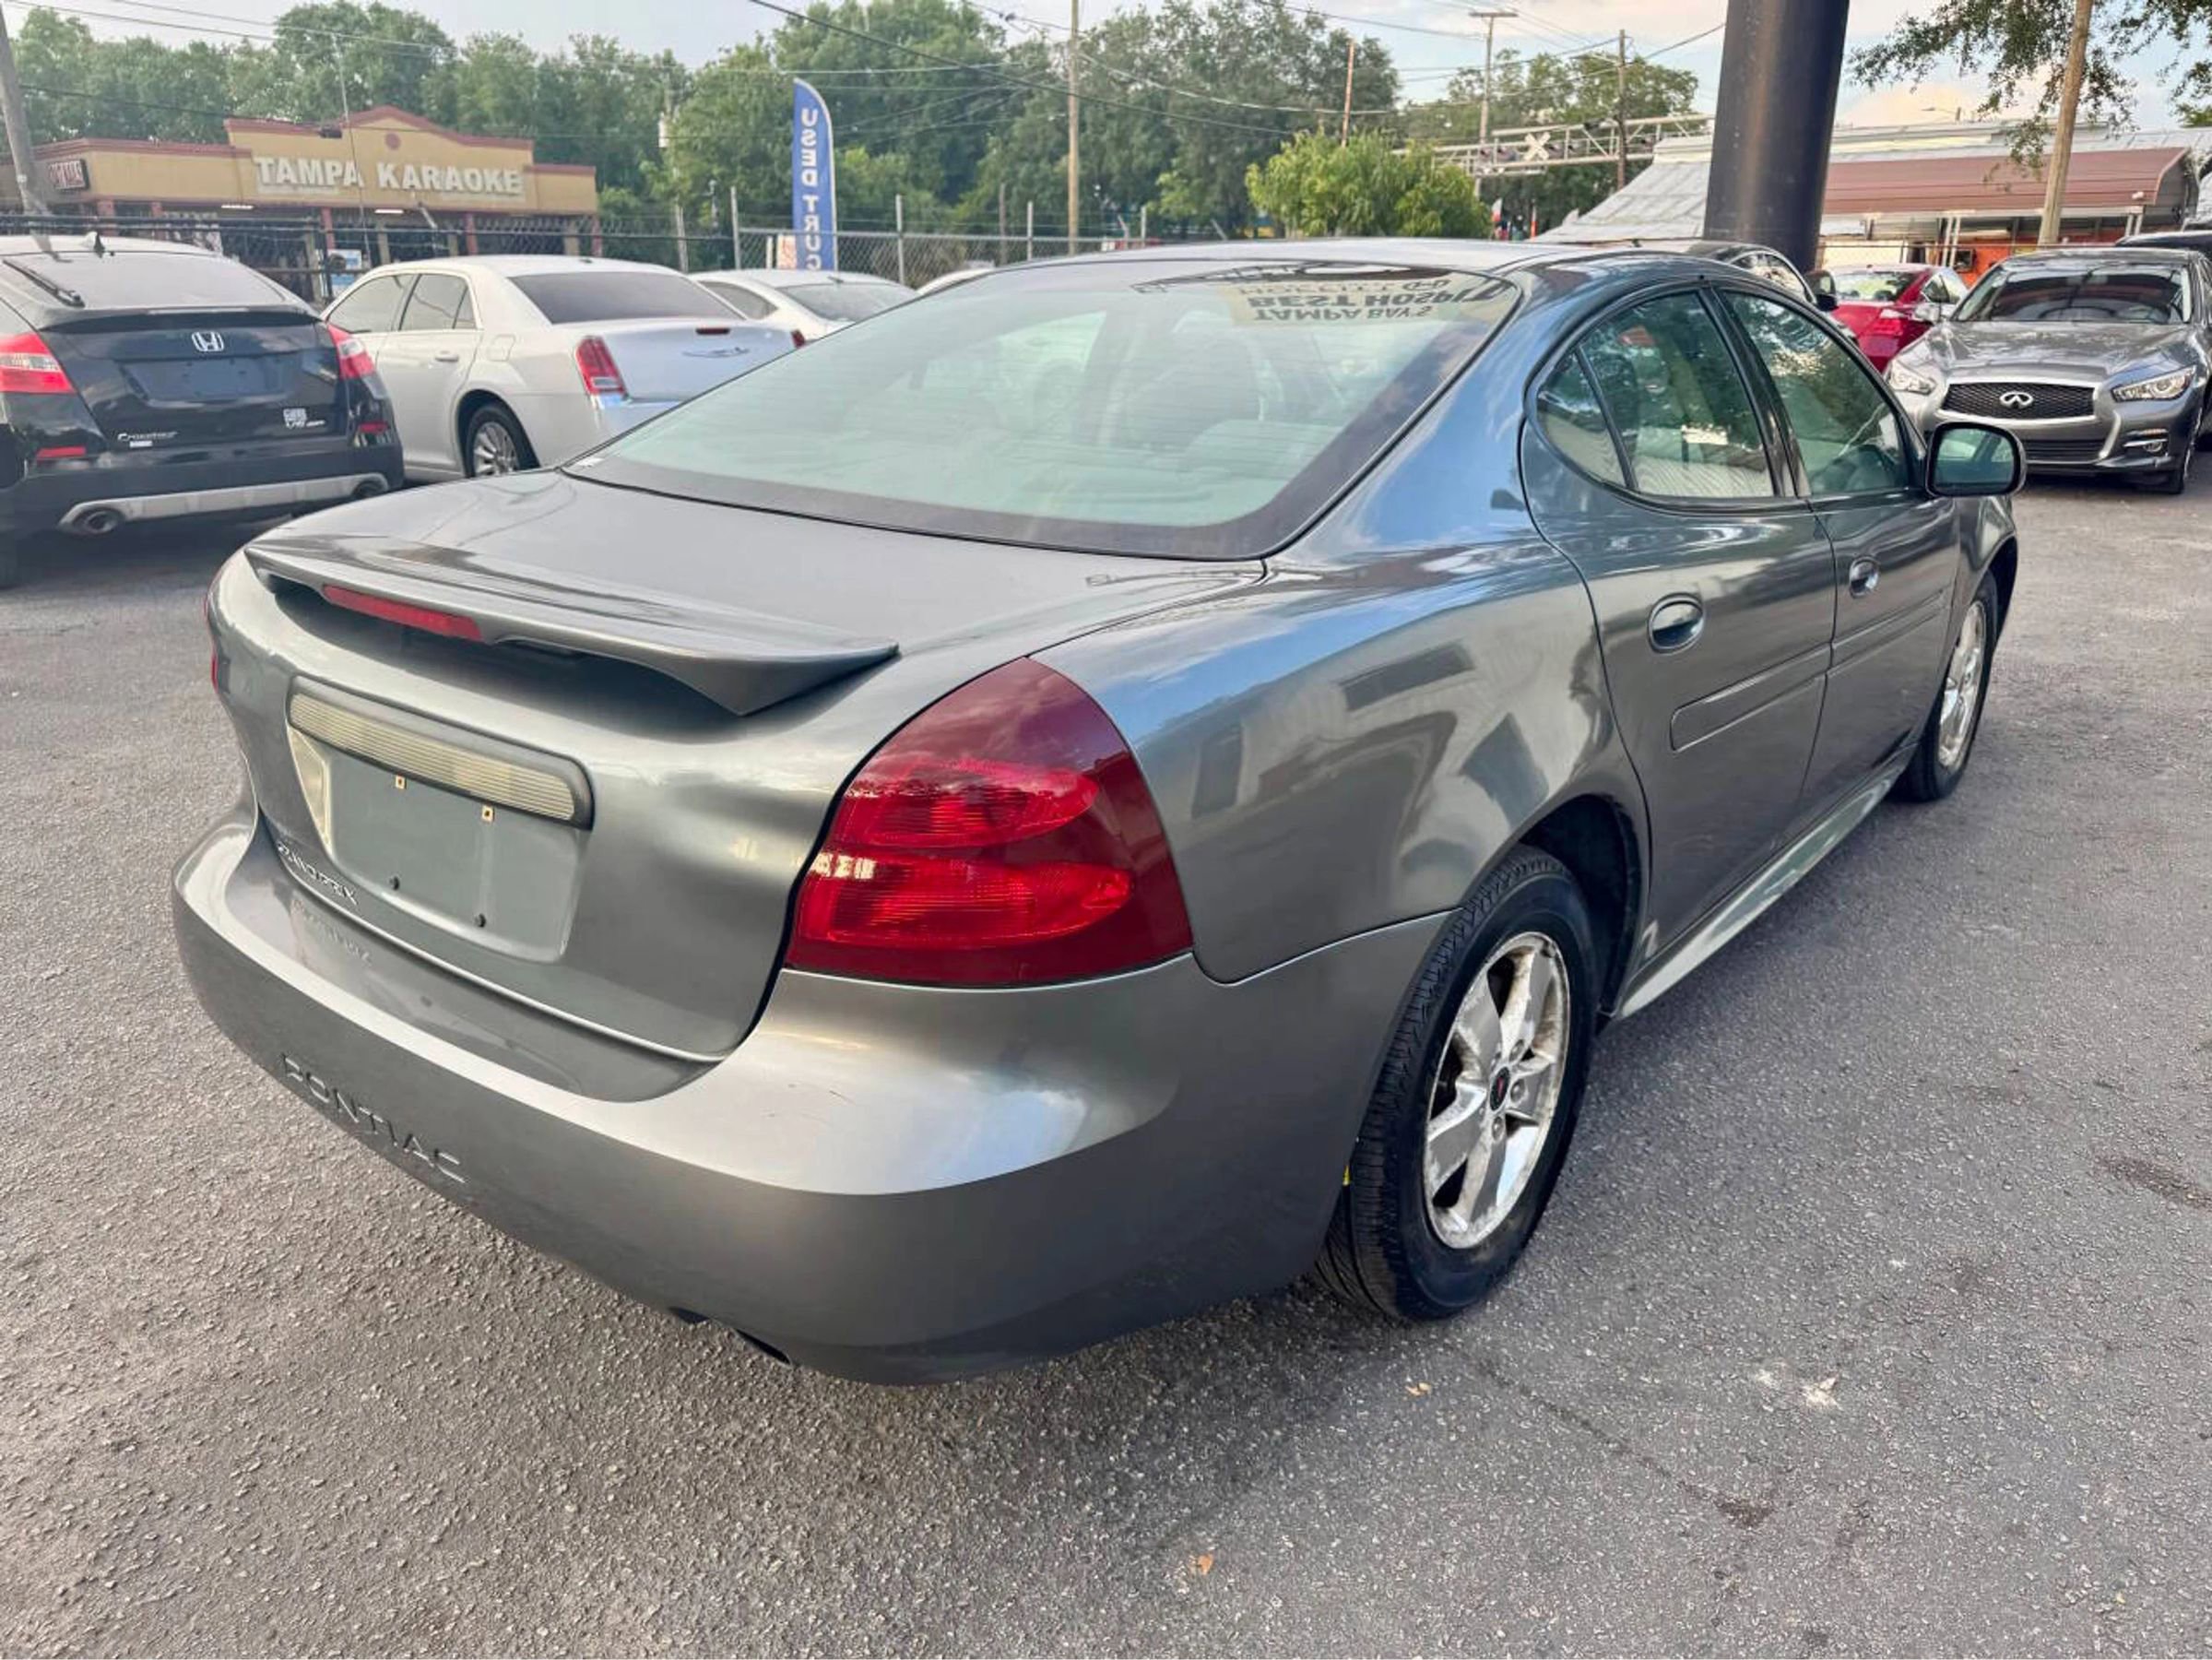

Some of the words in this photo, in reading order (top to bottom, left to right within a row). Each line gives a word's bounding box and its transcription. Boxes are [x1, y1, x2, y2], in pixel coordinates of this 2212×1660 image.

[253, 156, 365, 189] TAMPA
[376, 161, 525, 195] KARAOKE
[280, 1053, 467, 1184] PONTIAC
